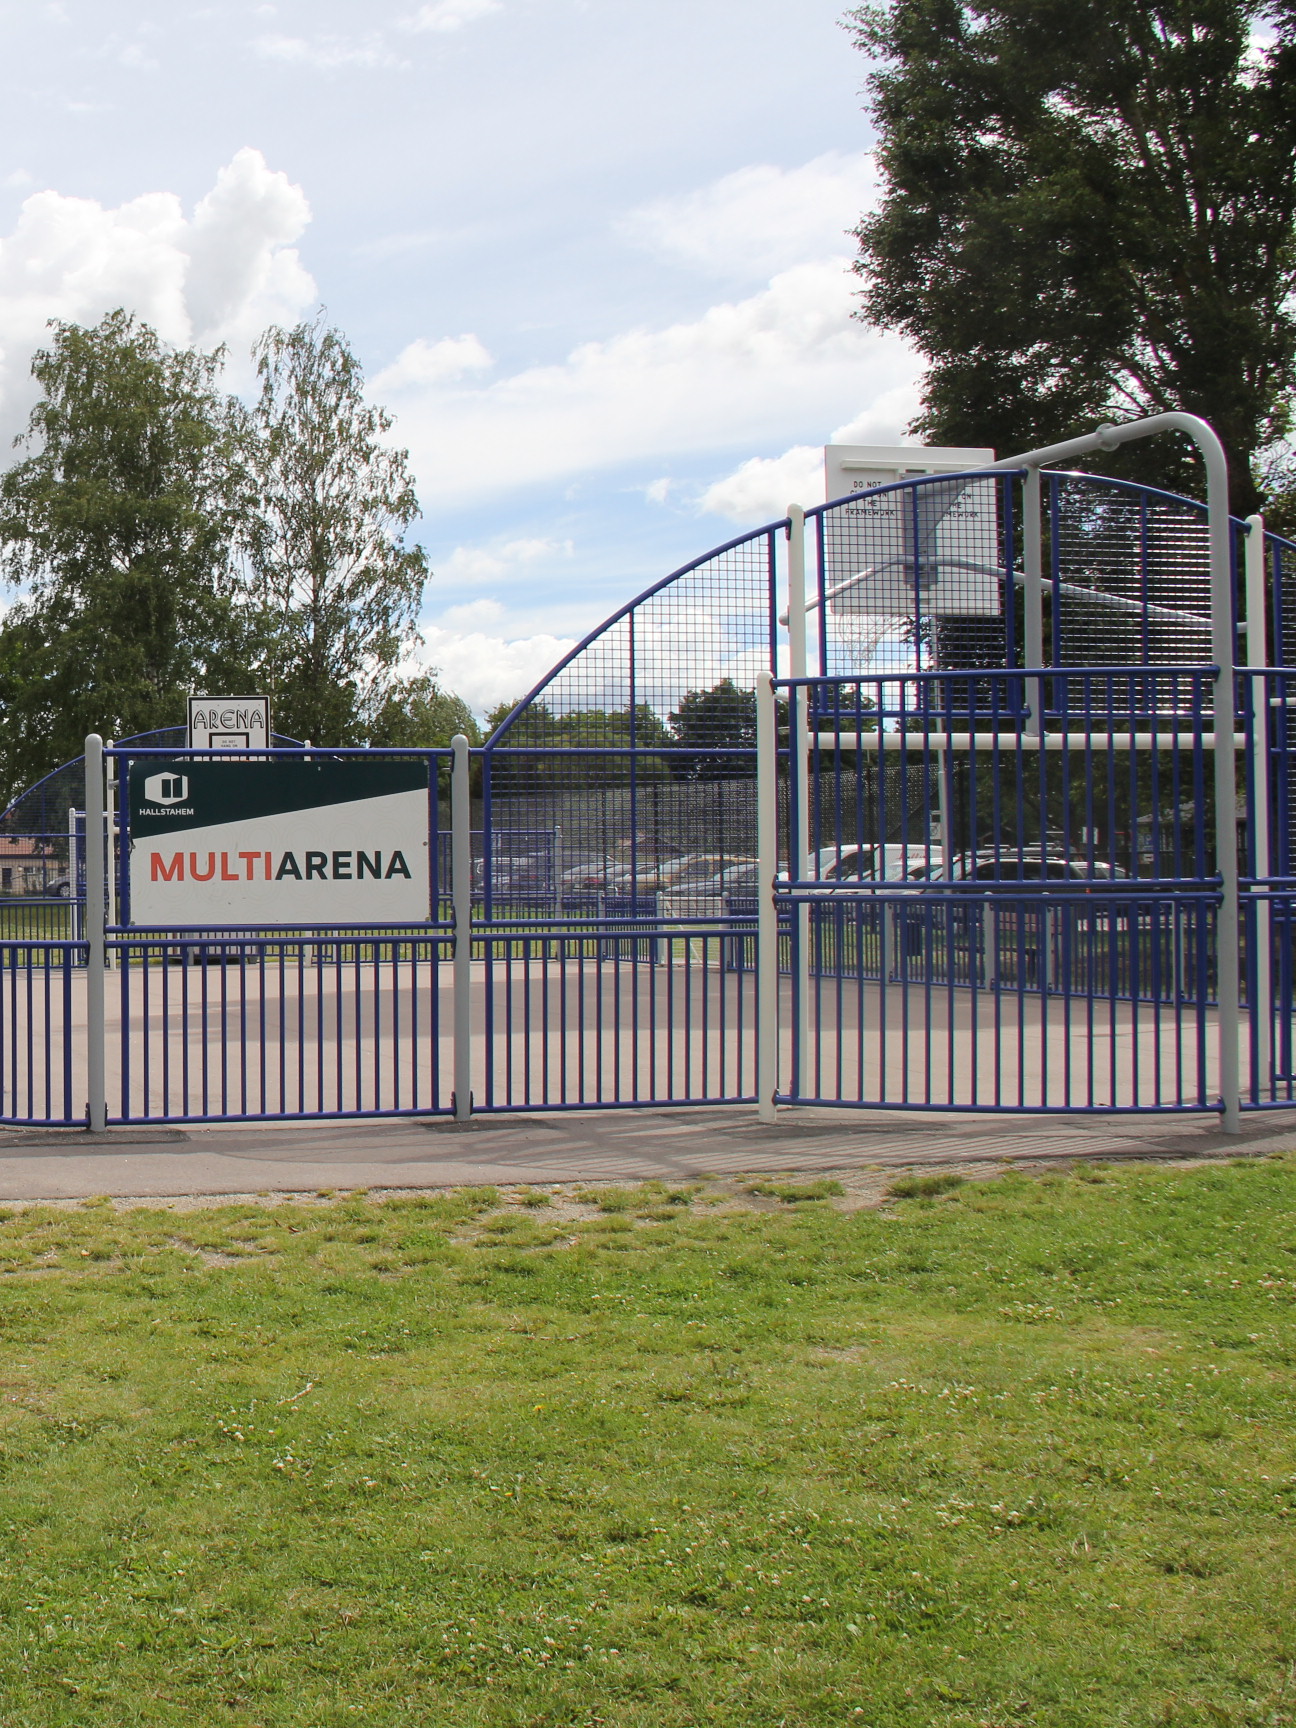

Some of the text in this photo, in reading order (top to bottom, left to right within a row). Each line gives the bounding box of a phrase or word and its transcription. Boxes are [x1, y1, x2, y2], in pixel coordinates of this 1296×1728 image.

[854, 480, 882, 489] DO NOT
[194, 709, 264, 729] ARENA
[139, 808, 194, 816] HALLSTAHEM
[150, 850, 412, 882] MULTIARENA
